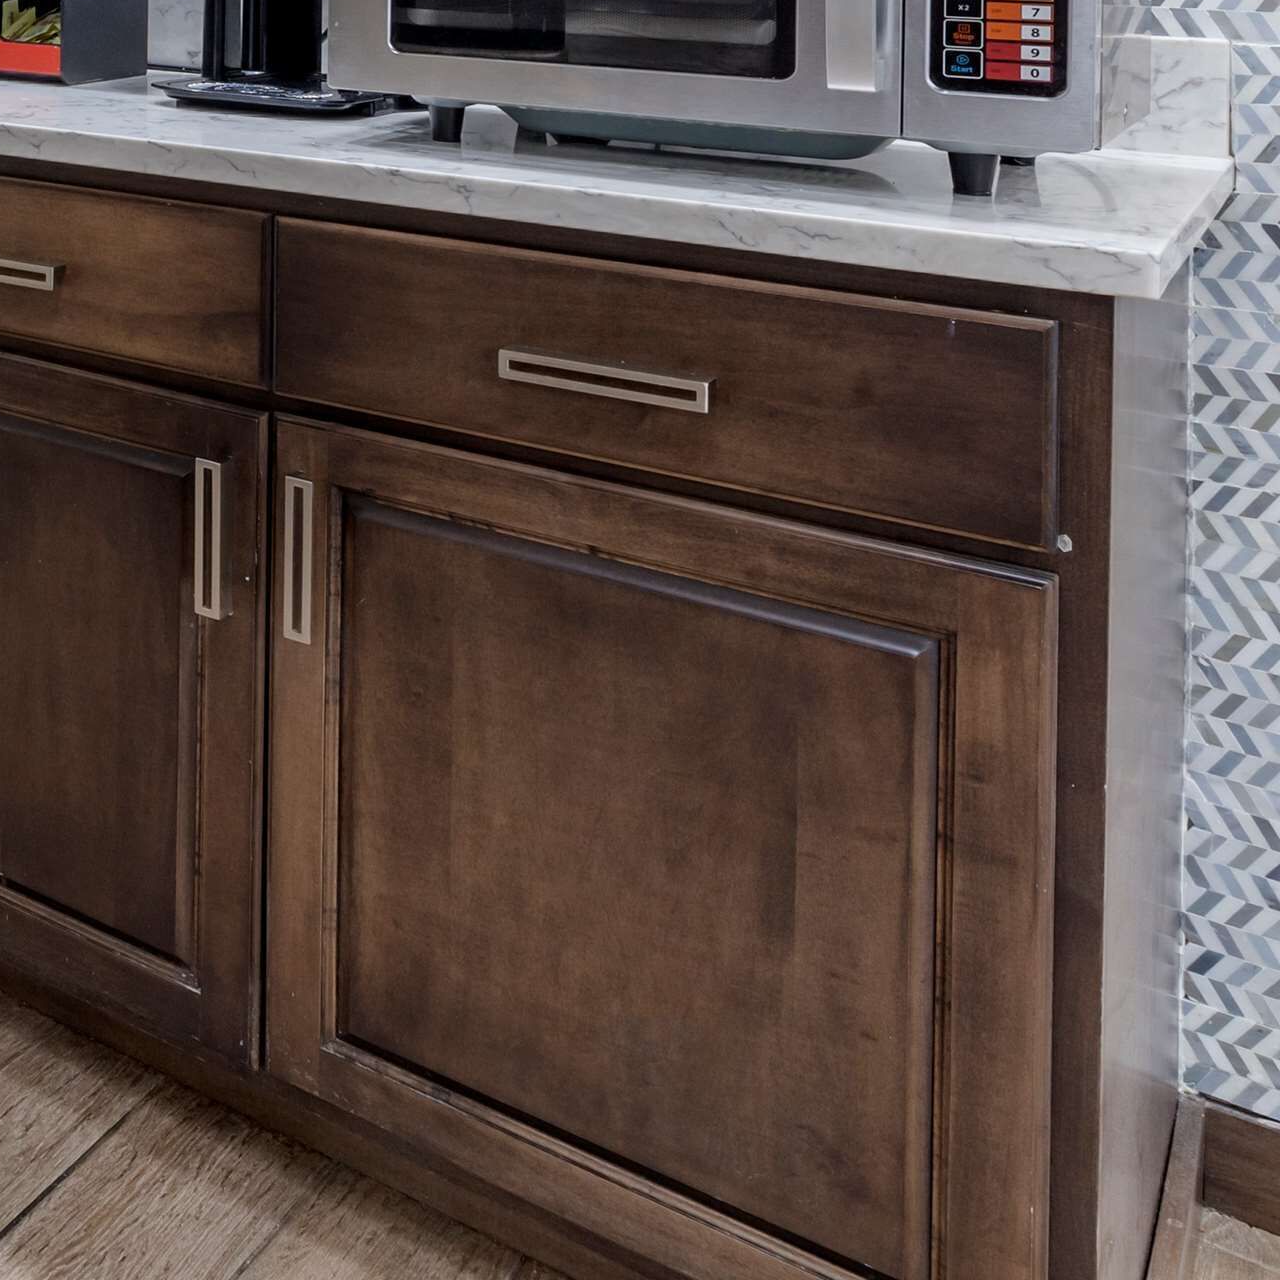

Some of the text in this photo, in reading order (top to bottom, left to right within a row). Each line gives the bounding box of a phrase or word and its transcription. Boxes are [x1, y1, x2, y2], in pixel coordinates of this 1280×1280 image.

[1032, 8, 1040, 17] 7
[1032, 28, 1040, 37] 8
[1031, 48, 1039, 57] 9
[951, 65, 973, 73] Start
[1031, 69, 1039, 77] 0
